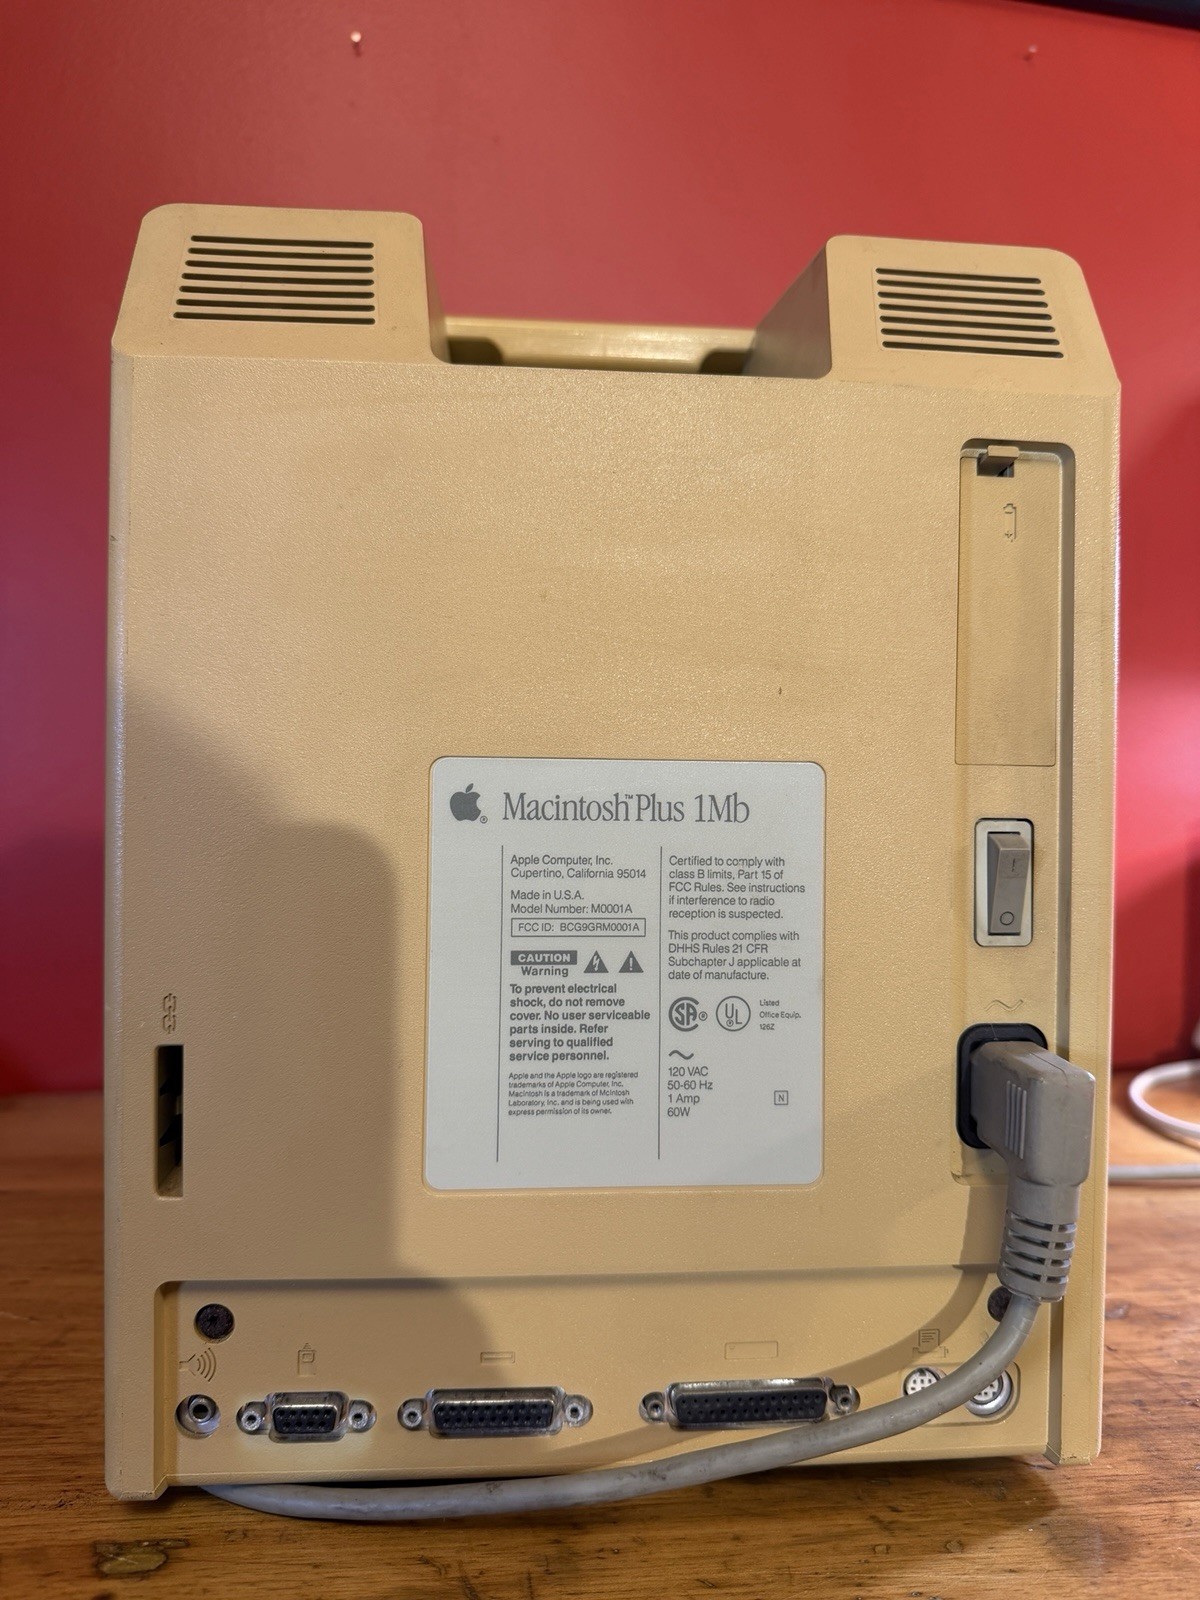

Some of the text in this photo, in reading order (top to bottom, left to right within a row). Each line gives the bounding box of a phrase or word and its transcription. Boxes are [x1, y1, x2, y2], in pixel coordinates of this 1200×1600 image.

[635, 793, 684, 822] Plus
[695, 792, 749, 823] 1Mb
[510, 855, 613, 868] Apple Computer, Inc.
[669, 855, 785, 868] Certified to comply with
[511, 867, 646, 879] Cupertino, California 95014
[669, 869, 783, 880] class B limits, Part 15 of
[669, 882, 805, 893] FCC Rules. See instructions
[511, 890, 584, 900] Made in U.S.A.
[669, 895, 775, 906] if interference to radio
[511, 904, 632, 913] Model Number: M0001A
[669, 909, 783, 920] reception is suspected.
[519, 922, 639, 932] FCC ID: BCG9GRM0001A
[668, 930, 799, 942] This product complies with
[669, 943, 768, 953] DHHS Rules 21 CFR
[518, 954, 570, 962] CAUTION
[668, 956, 801, 969] Subchapter J applicable at
[521, 966, 568, 977] Warning
[668, 970, 769, 980] date of manufacture.
[510, 983, 616, 996] To prevent electrical
[510, 997, 625, 1008] shock, do not remove
[544, 1011, 559, 1020] No
[562, 1012, 586, 1020] user
[589, 1010, 650, 1020] serviceable
[781, 1011, 801, 1019] Equip.
[510, 1024, 608, 1036] parts inside. Refer
[510, 1037, 613, 1049] serving to qualified
[510, 1050, 609, 1063] service personnel.
[577, 1072, 592, 1081] logo
[605, 1071, 638, 1080] registered
[669, 1066, 708, 1077] 120 VAC
[555, 1081, 575, 1089] Apple
[667, 1080, 713, 1090] 50-60 Hz
[582, 1099, 601, 1108] being
[668, 1094, 700, 1105] 1 Amp
[779, 1094, 784, 1102] N
[536, 1108, 572, 1116] permission
[667, 1107, 690, 1117] 60W
